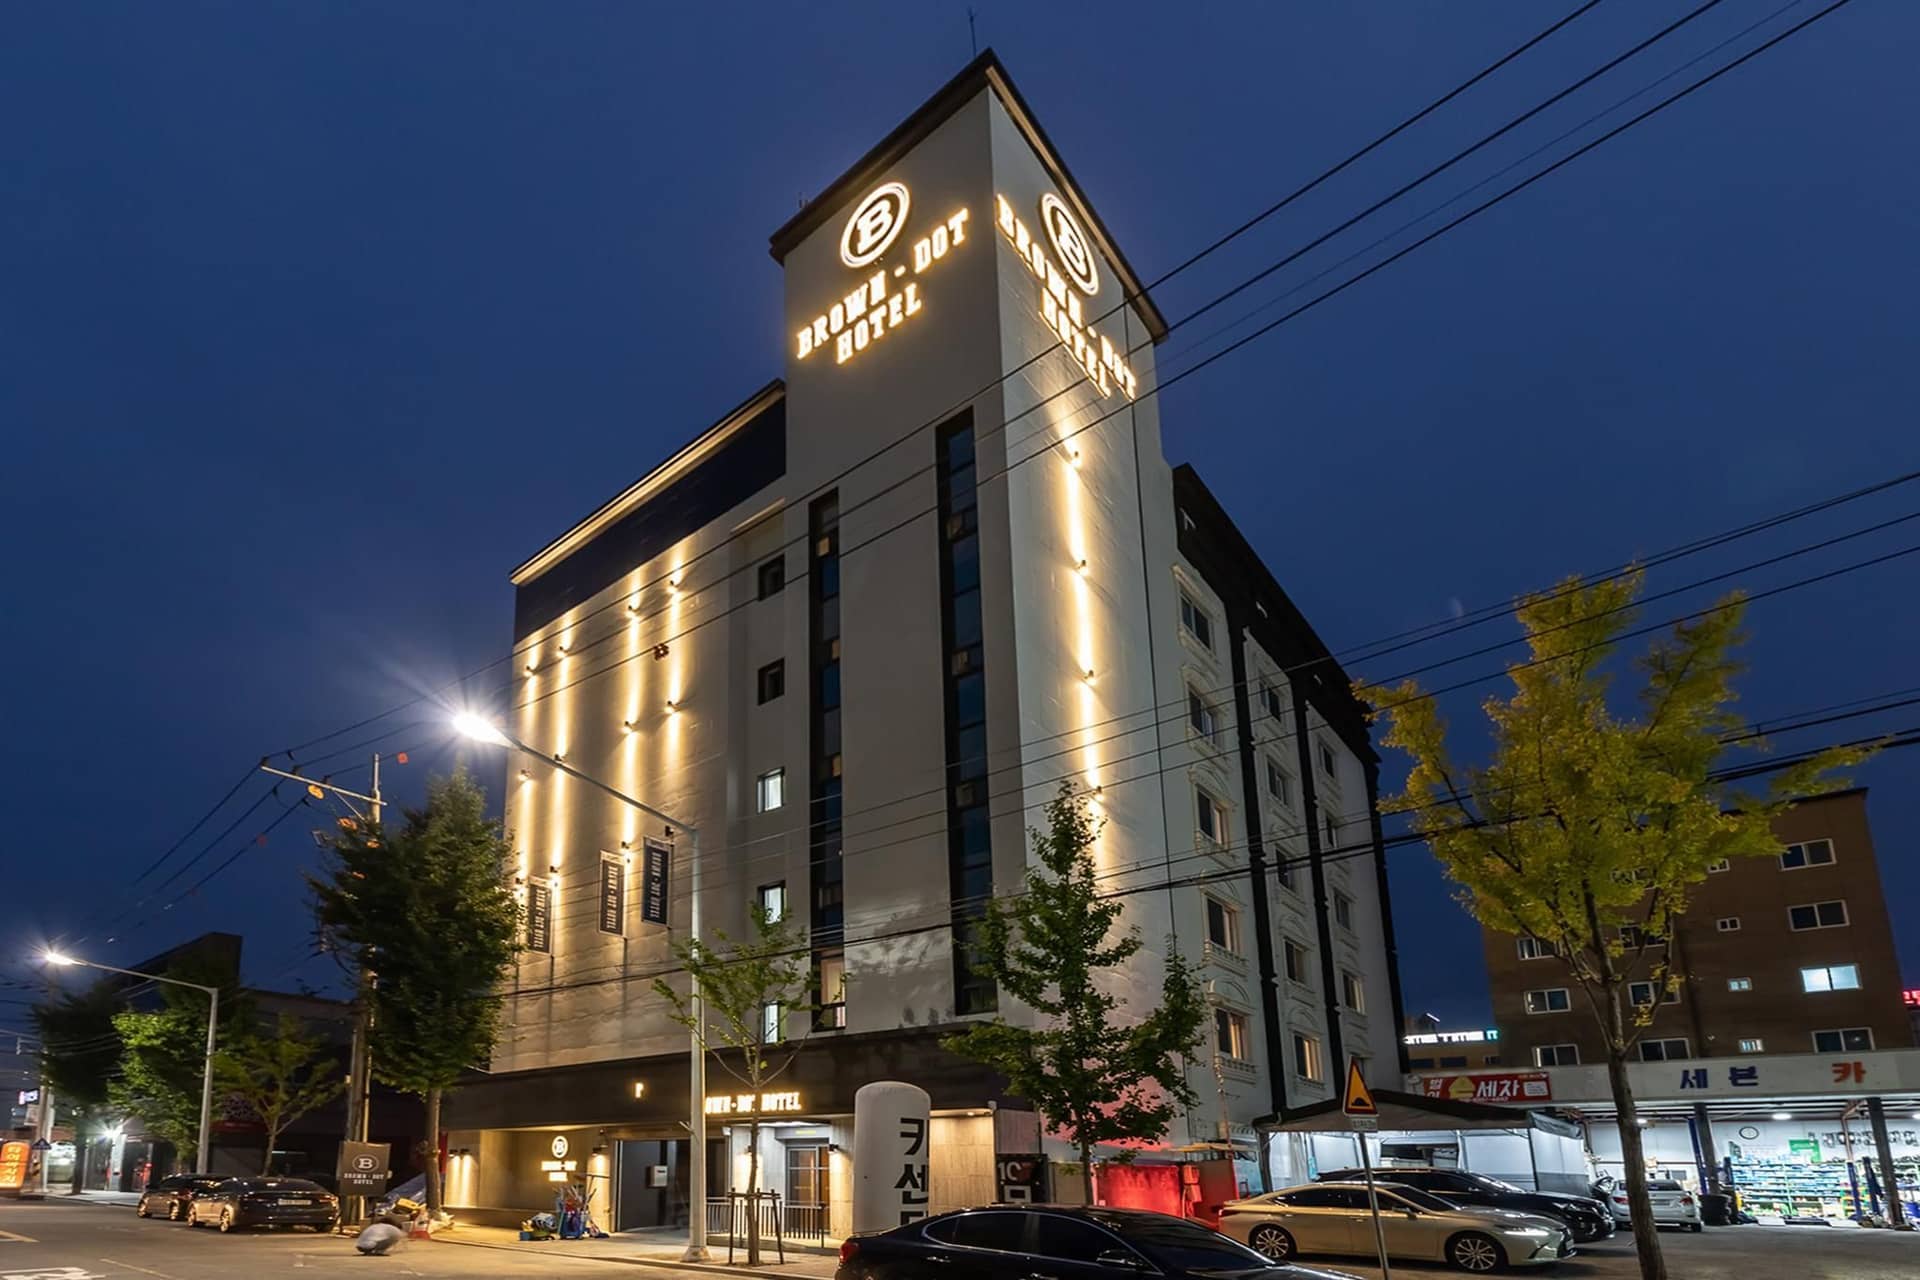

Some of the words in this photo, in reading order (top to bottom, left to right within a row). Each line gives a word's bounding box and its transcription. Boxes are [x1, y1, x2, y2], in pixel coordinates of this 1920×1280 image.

[797, 269, 887, 360] BROWN
[913, 207, 969, 275] DOT
[836, 282, 922, 365] HOTEL
[1832, 1061, 1866, 1084] 카
[1477, 1079, 1520, 1098] 세차
[761, 1092, 802, 1112] HOTEL
